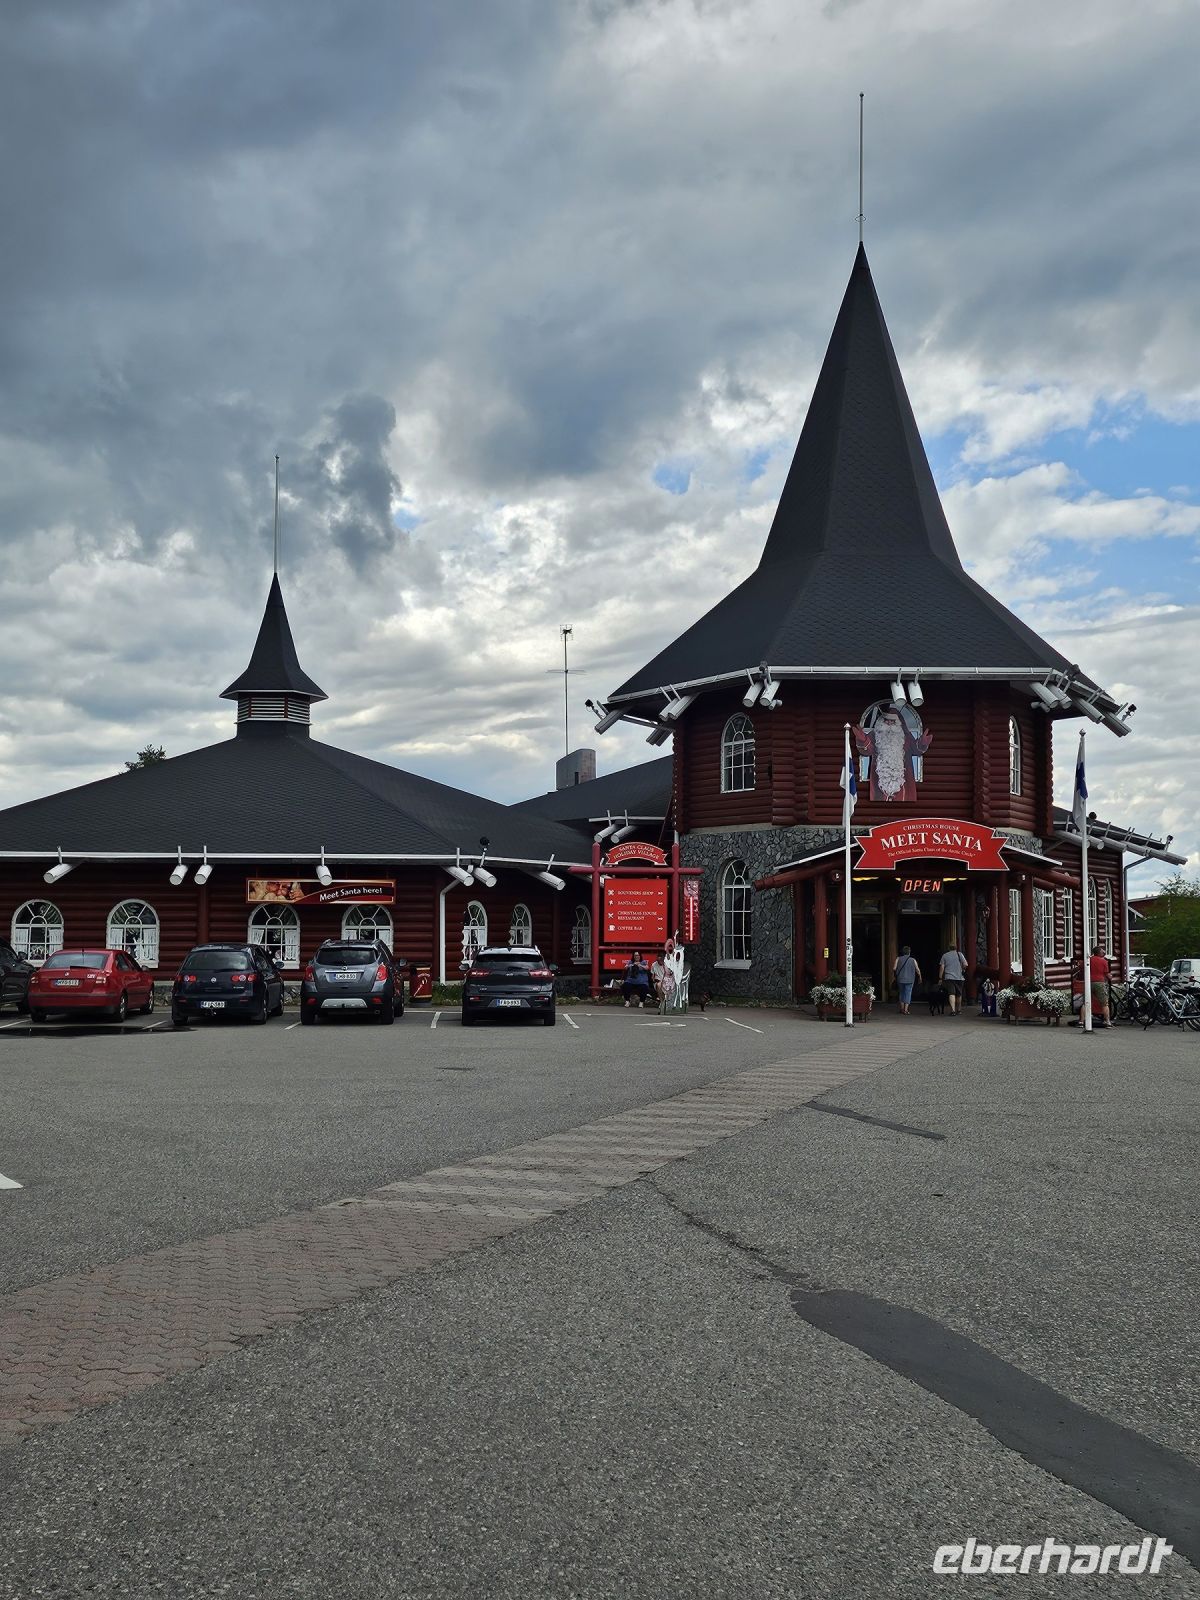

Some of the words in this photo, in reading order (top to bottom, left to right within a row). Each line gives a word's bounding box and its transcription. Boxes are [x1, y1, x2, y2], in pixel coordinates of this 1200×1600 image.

[939, 824, 960, 832] HOUSE
[881, 832, 928, 850] MEET
[932, 832, 982, 851] SANTA
[613, 850, 637, 859] HOLIDAY
[637, 850, 660, 859] VILLAGE
[904, 880, 941, 892] OPEN
[319, 891, 339, 902] Meet
